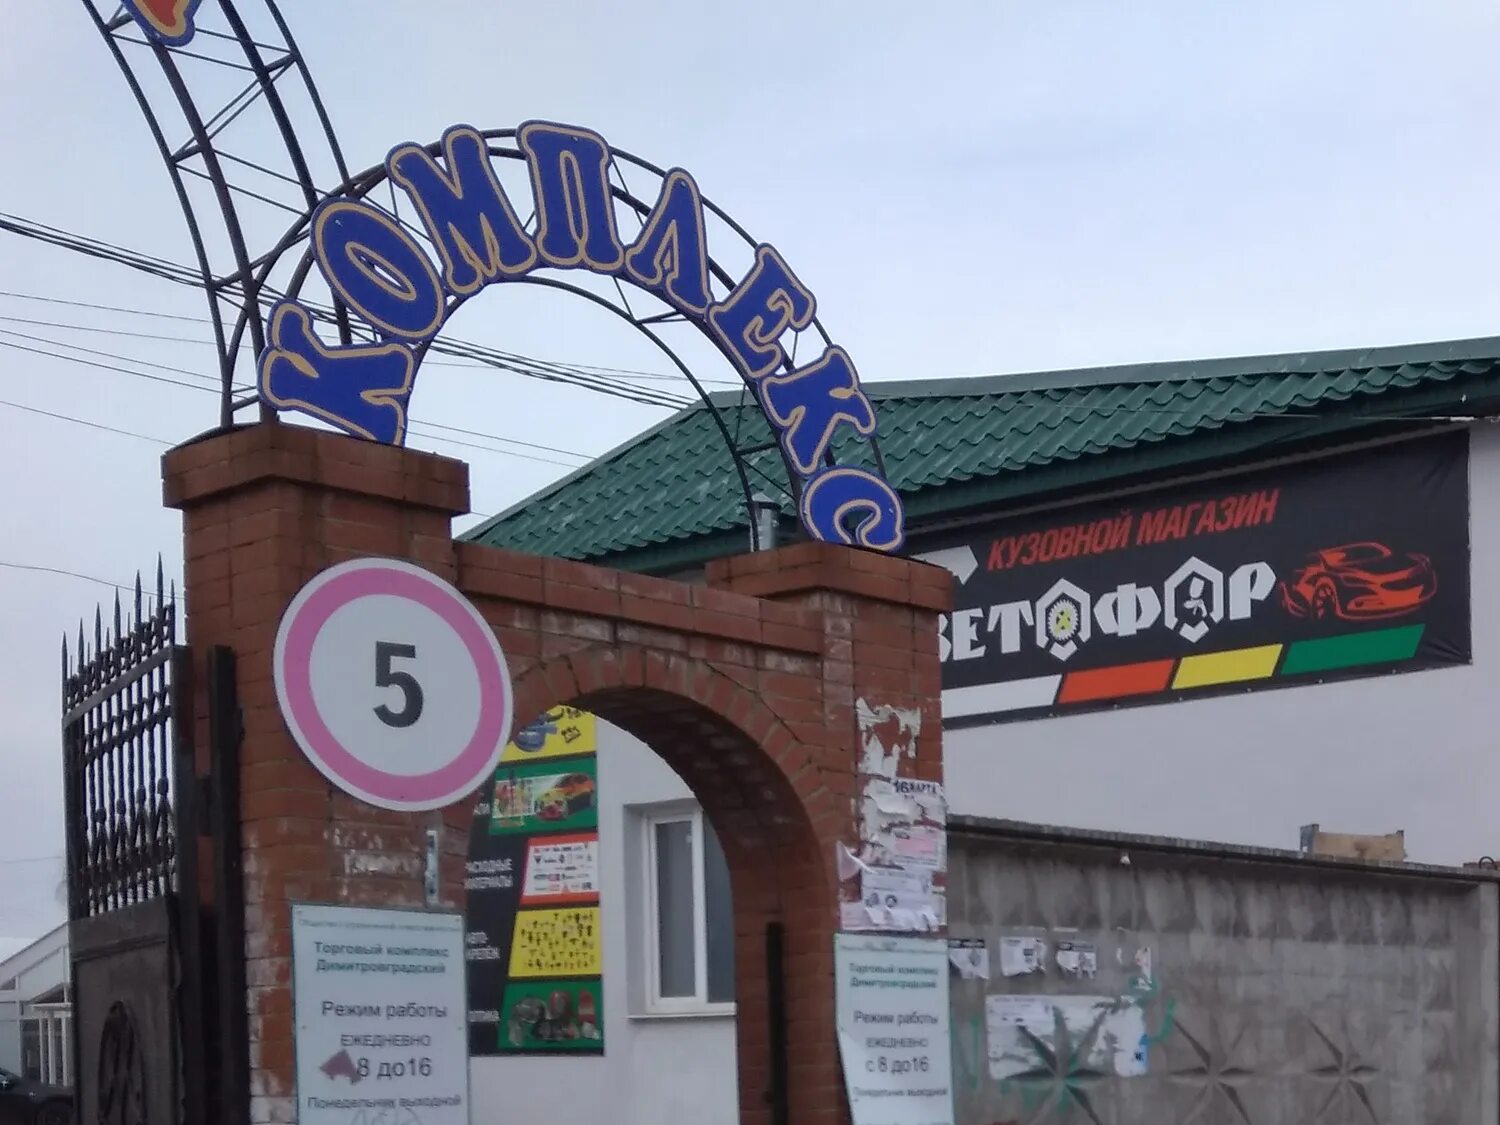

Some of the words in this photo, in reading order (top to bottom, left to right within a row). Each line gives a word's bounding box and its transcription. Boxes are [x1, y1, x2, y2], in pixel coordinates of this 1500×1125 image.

[258, 120, 903, 553] КОМПЛЕКС
[987, 509, 1131, 572] КУЗОВНОЙ
[1136, 489, 1279, 544] МАГАЗИН
[373, 641, 424, 728] 5
[314, 941, 382, 956] Торговый
[321, 1001, 380, 1017] Режим
[386, 1002, 447, 1018] работы
[340, 1033, 431, 1048] ЕЖЕДНЕВНО
[356, 1057, 369, 1077] 8
